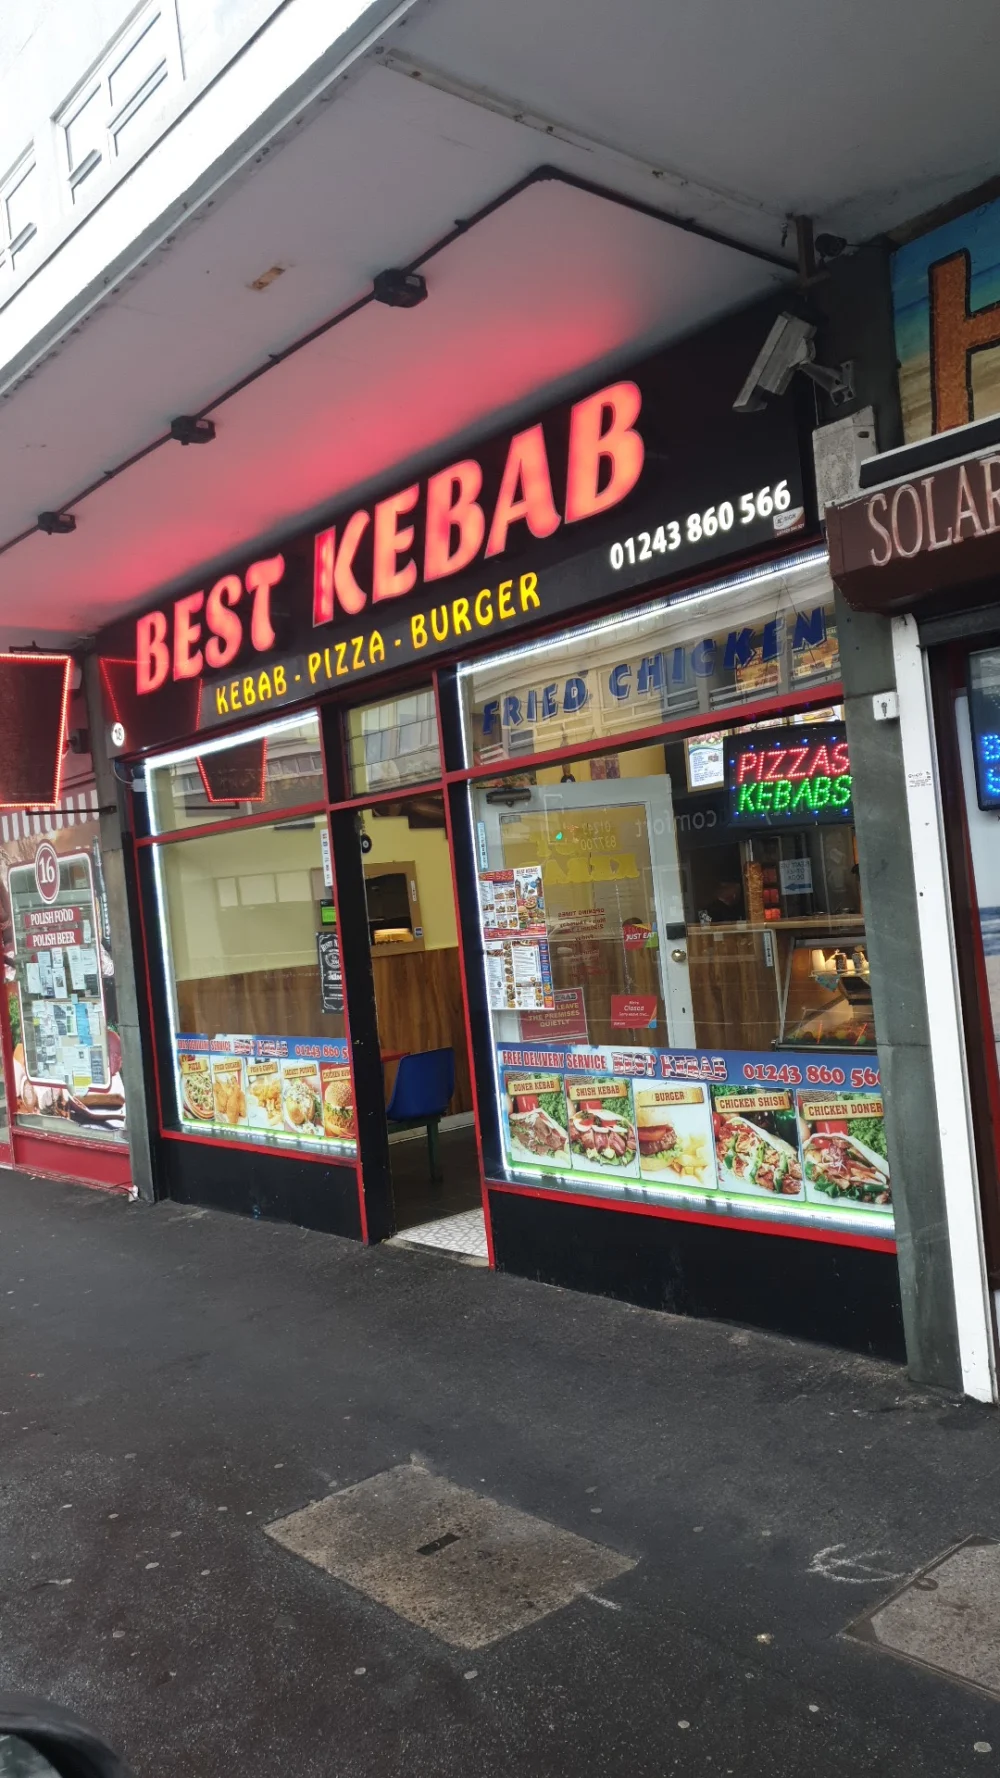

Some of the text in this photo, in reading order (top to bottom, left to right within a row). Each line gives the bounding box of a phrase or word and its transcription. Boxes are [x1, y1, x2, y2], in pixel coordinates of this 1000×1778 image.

[867, 455, 1000, 566] SOLAR
[609, 479, 791, 569] 01243 860 566
[136, 380, 645, 696] BEST KEBAB
[215, 665, 287, 715] KEBAB
[308, 630, 386, 684] PIZZA
[410, 572, 540, 649] BURGER
[482, 607, 827, 736] FRIED CHICKEN
[738, 743, 851, 782] PIZZAS
[738, 775, 853, 812] KEBABS
[38, 855, 56, 884] 16
[30, 908, 74, 926] POLISH FOOD
[32, 931, 75, 947] POLISH BEER
[626, 932, 656, 941] JUST EAT
[540, 1019, 570, 1028] QUIETLY
[544, 1010, 580, 1020] PREMISES
[323, 1044, 340, 1057] 860
[502, 1051, 522, 1066] FREE
[523, 1052, 564, 1068] DELIVERY
[566, 1054, 607, 1071] SERVICE
[611, 1052, 657, 1077] BEST
[660, 1055, 728, 1082] KEBAB
[742, 1063, 803, 1084] 01243
[806, 1064, 846, 1085] 860
[513, 1080, 555, 1092] DONER KEBAB
[576, 1085, 621, 1096] SHISH KEBAB
[654, 1091, 685, 1102] BURGER
[719, 1095, 786, 1109] CHICKEN SHISH
[808, 1102, 883, 1116] CHICKEN DONER
